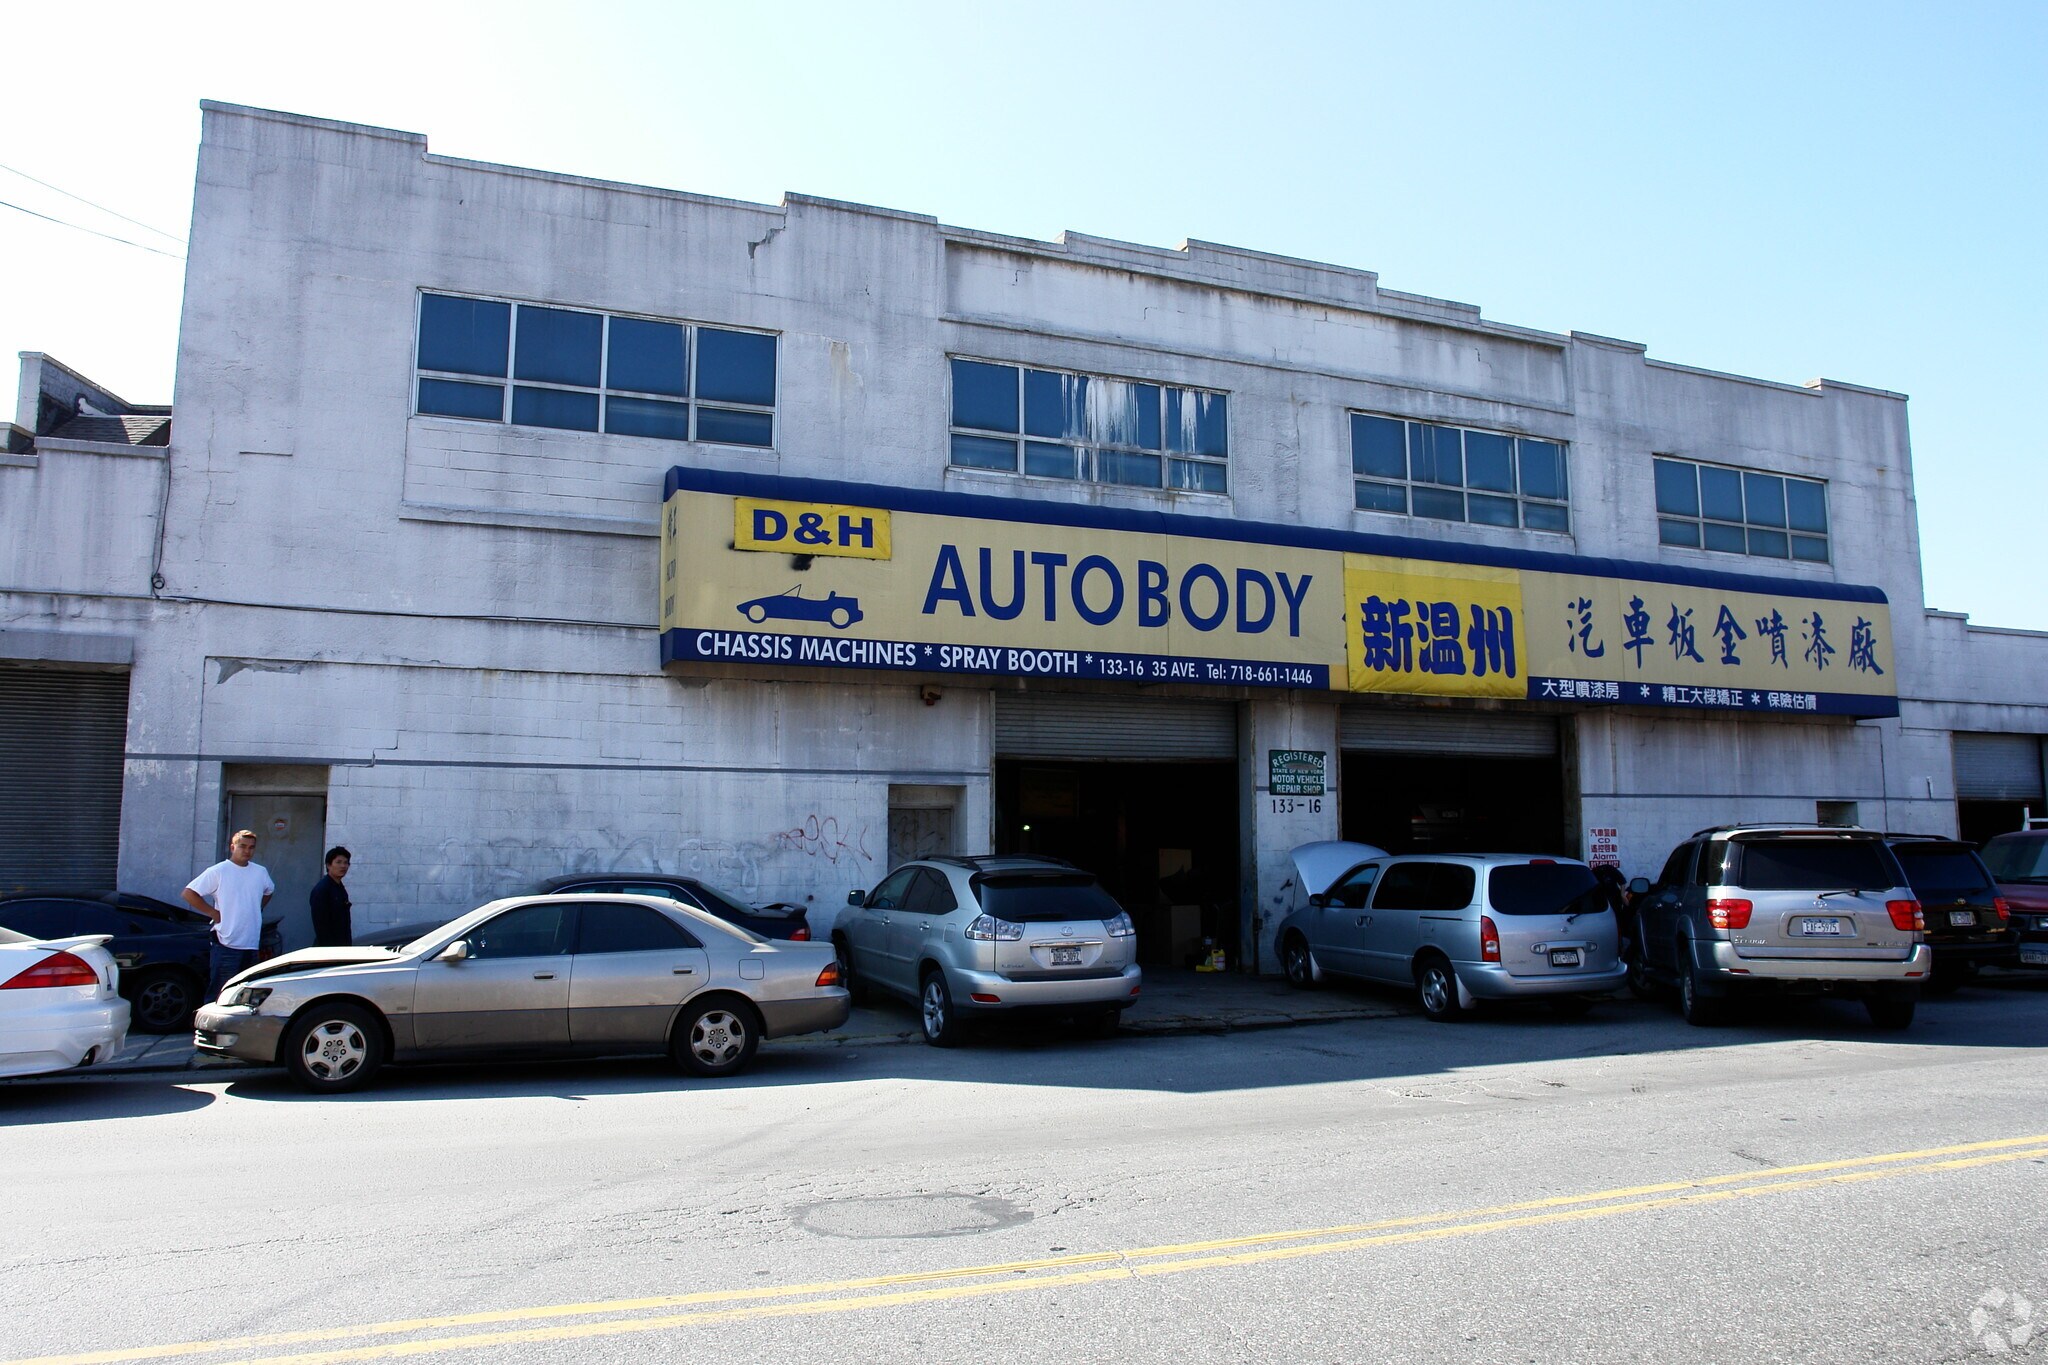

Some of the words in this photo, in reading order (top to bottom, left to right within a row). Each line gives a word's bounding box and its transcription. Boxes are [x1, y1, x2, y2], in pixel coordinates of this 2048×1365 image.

[753, 509, 873, 548] D&H
[696, 632, 792, 659] CHASSIS
[799, 637, 917, 666] MACHINES
[940, 646, 1001, 670] SPRAY
[1008, 649, 1078, 673] BOOTH
[1099, 658, 1144, 676] 133-16
[1152, 661, 1167, 677] 35
[1170, 662, 1199, 678] AVE.
[1206, 664, 1227, 680] Tel:
[1230, 665, 1312, 684] 718-661-1446
[1272, 752, 1323, 768] REGISTERED
[1272, 774, 1295, 783] MOTOR
[1296, 775, 1325, 784] VEHICLE
[1276, 784, 1301, 793] REPAIR
[1303, 785, 1321, 794] SHOP
[1272, 798, 1321, 813] 133-16
